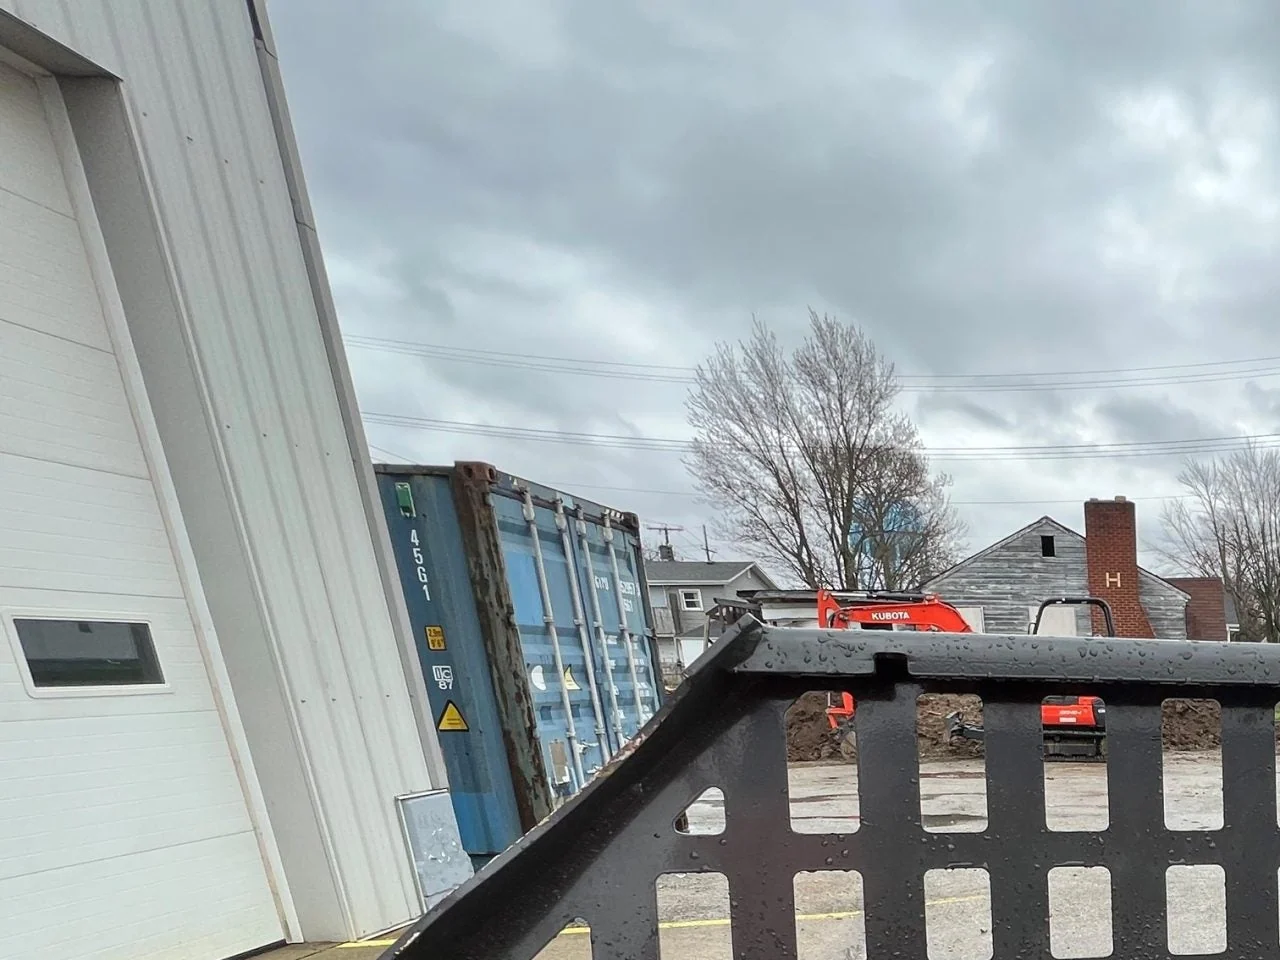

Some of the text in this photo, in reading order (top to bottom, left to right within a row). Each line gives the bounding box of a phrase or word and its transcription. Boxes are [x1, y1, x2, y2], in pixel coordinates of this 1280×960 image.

[411, 529, 431, 602] 45G1
[1105, 572, 1121, 588] H
[871, 611, 910, 620] KUBOTA
